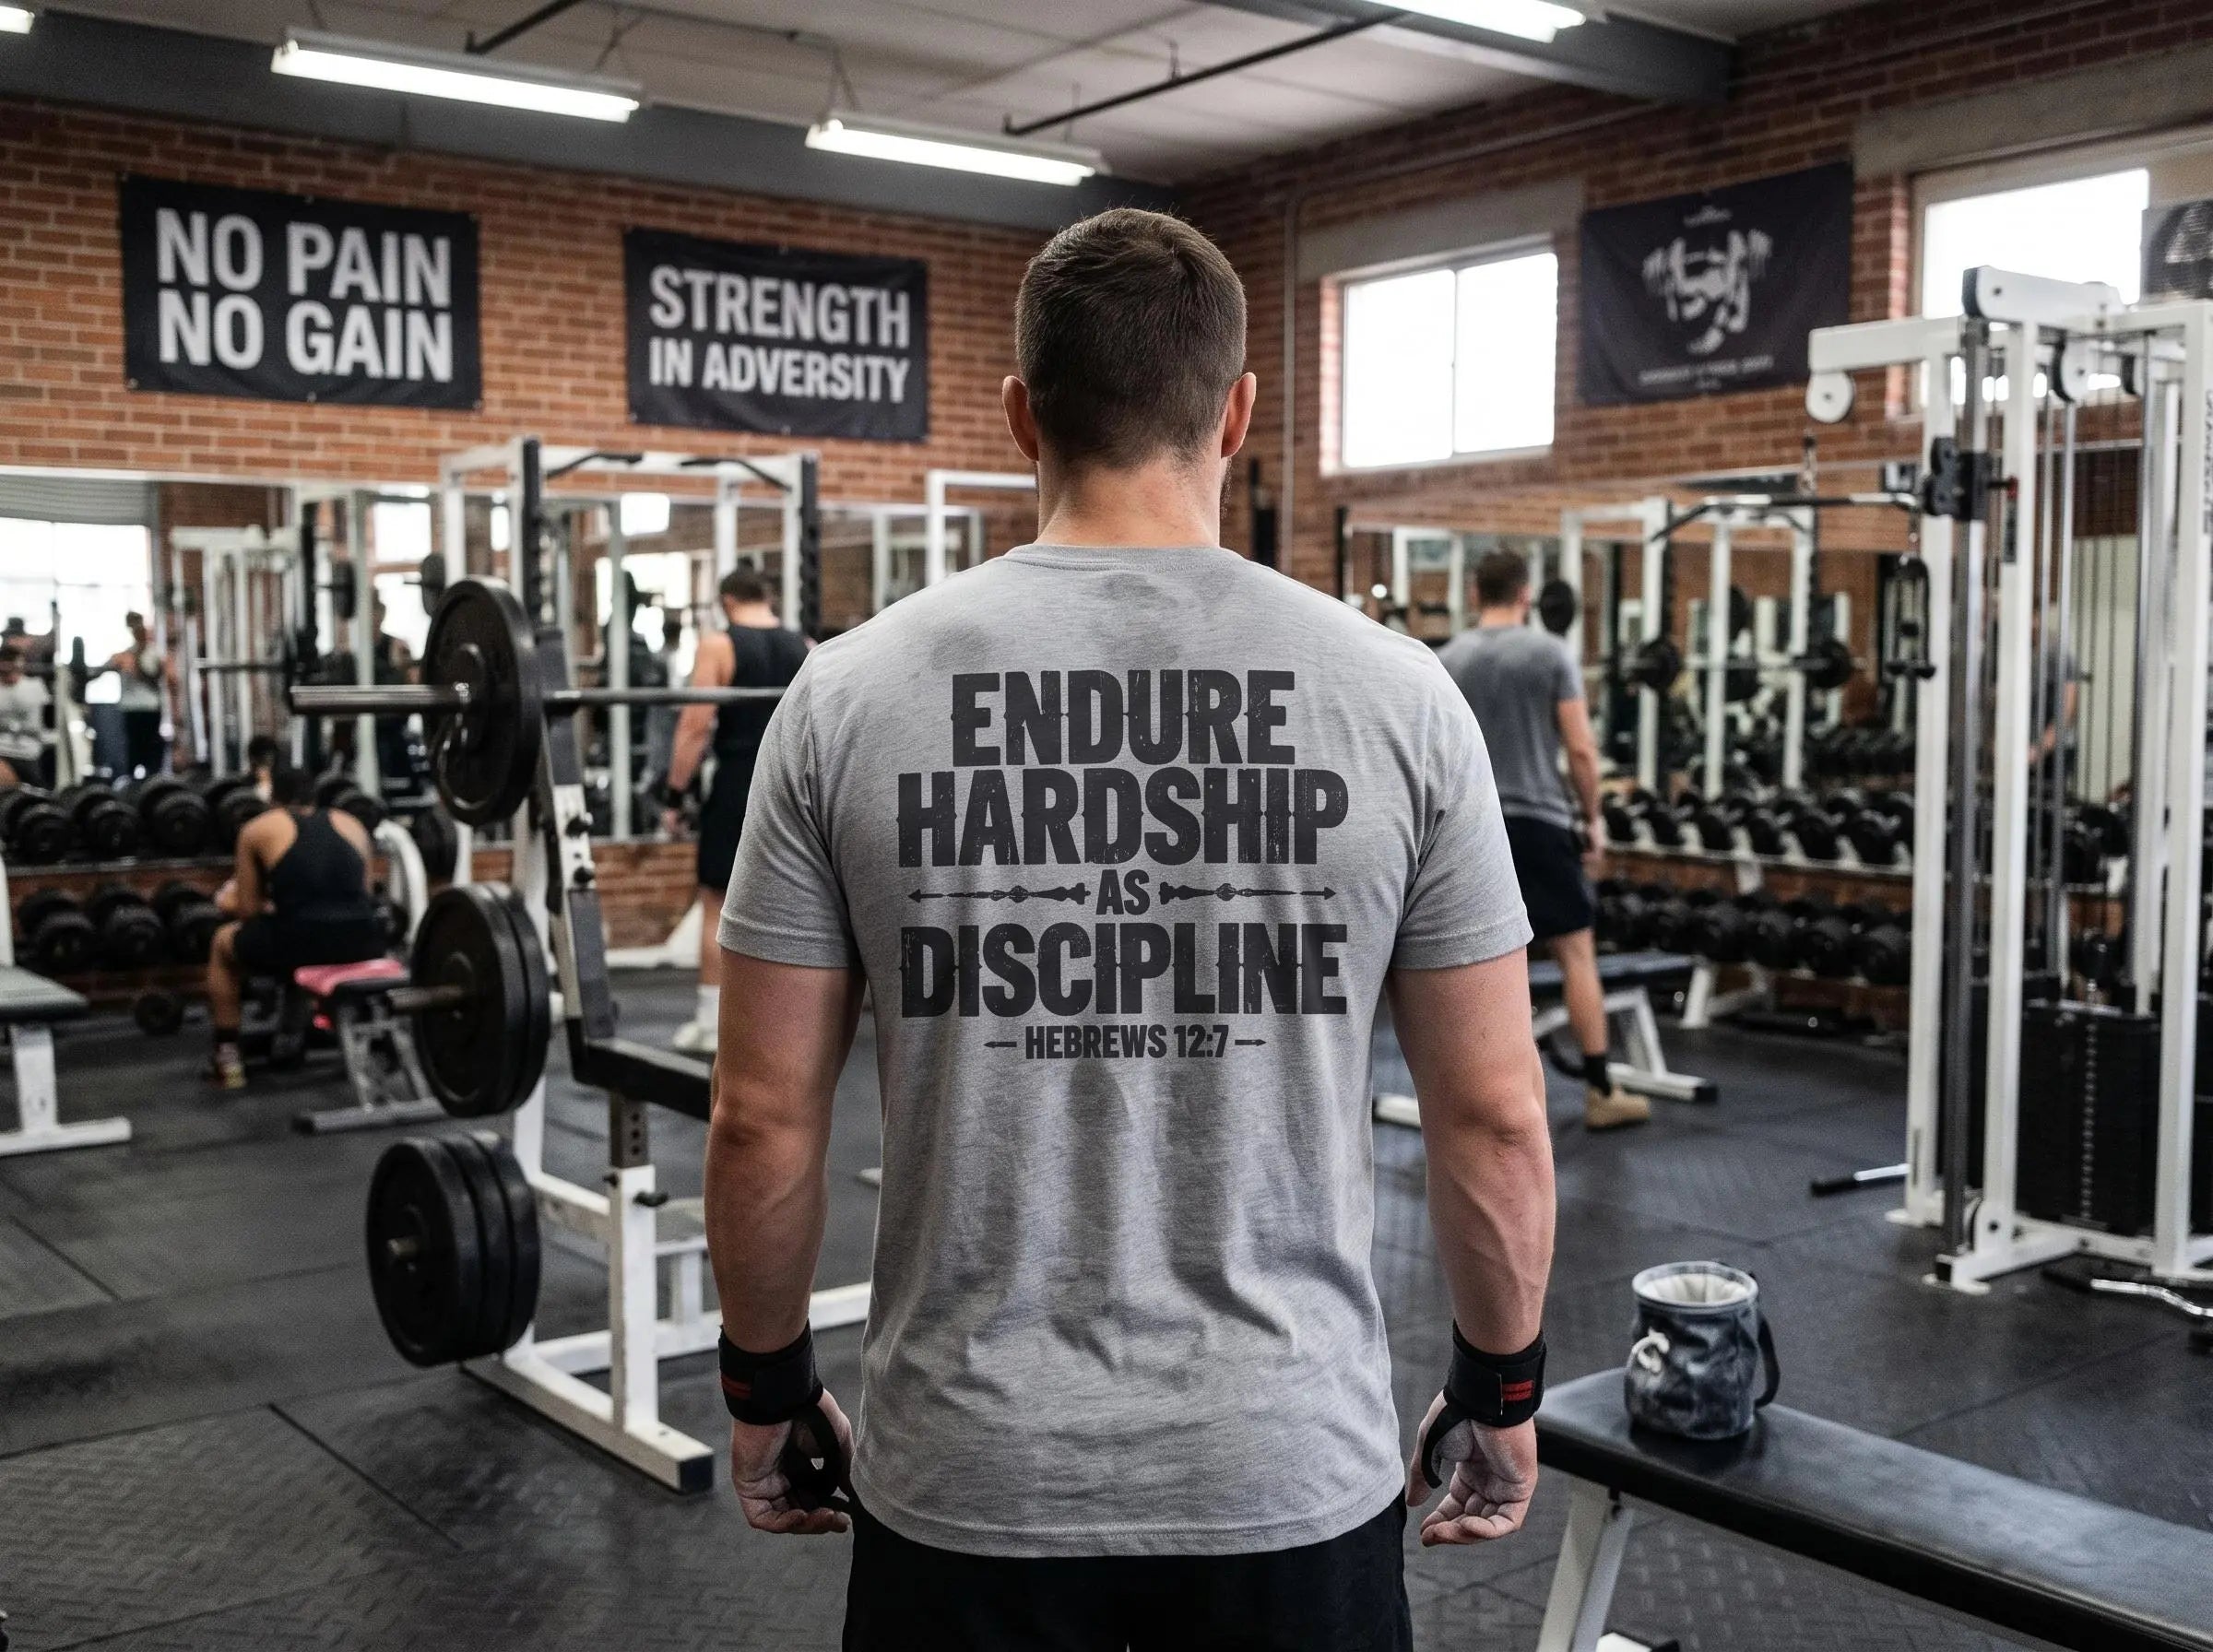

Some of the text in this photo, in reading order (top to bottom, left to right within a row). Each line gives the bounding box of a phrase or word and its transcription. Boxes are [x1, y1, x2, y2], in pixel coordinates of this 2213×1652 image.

[157, 208, 450, 307] NO PAIN
[158, 289, 453, 383] NO GAIN
[649, 265, 910, 348] STRENGTH
[649, 336, 910, 404] IN ADVERSITY
[951, 669, 1296, 767] ENDURE
[896, 767, 1349, 867] HARDSHIP
[1095, 869, 1151, 915] AS
[899, 922, 1348, 1019] DISCIPLINE
[1025, 1023, 1229, 1060] HEBREWS 12:7
